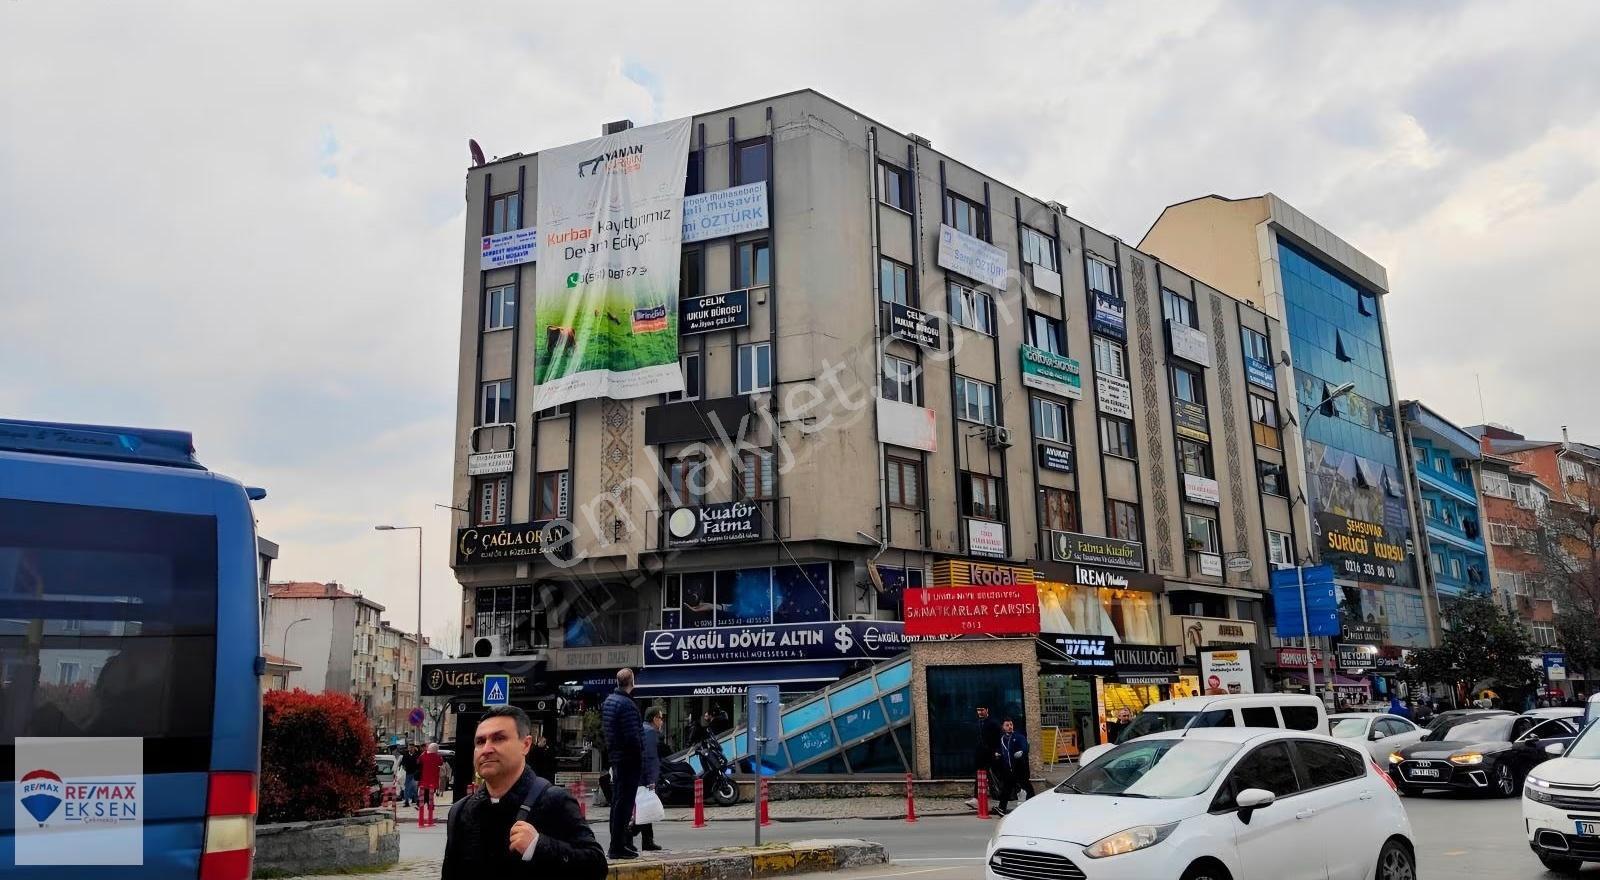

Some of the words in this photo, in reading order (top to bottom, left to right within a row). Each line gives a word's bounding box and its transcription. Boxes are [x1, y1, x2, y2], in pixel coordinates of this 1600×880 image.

[605, 145, 642, 161] YANAN
[707, 194, 762, 212] Müşavir
[701, 207, 763, 229] ÖZTÜRK
[699, 296, 726, 309] ÇELİK
[710, 305, 742, 317] BÜROSU
[699, 502, 756, 521] Kuaför
[703, 520, 752, 534] Fatma
[482, 530, 523, 550] ÇAĞLA
[1078, 541, 1104, 555] Fatma
[1106, 544, 1135, 558] Kuaför
[1374, 541, 1405, 562] KURSU
[1345, 559, 1361, 573] 0216
[993, 603, 1036, 618] ÇARŞISI
[676, 630, 725, 651] AKGÜL
[729, 628, 776, 648] DÖVİZ
[780, 629, 824, 647] ALTIN
[878, 631, 900, 644] AKGÜL
[716, 685, 737, 694] DÖVİZ
[1582, 823, 1595, 834] 70
